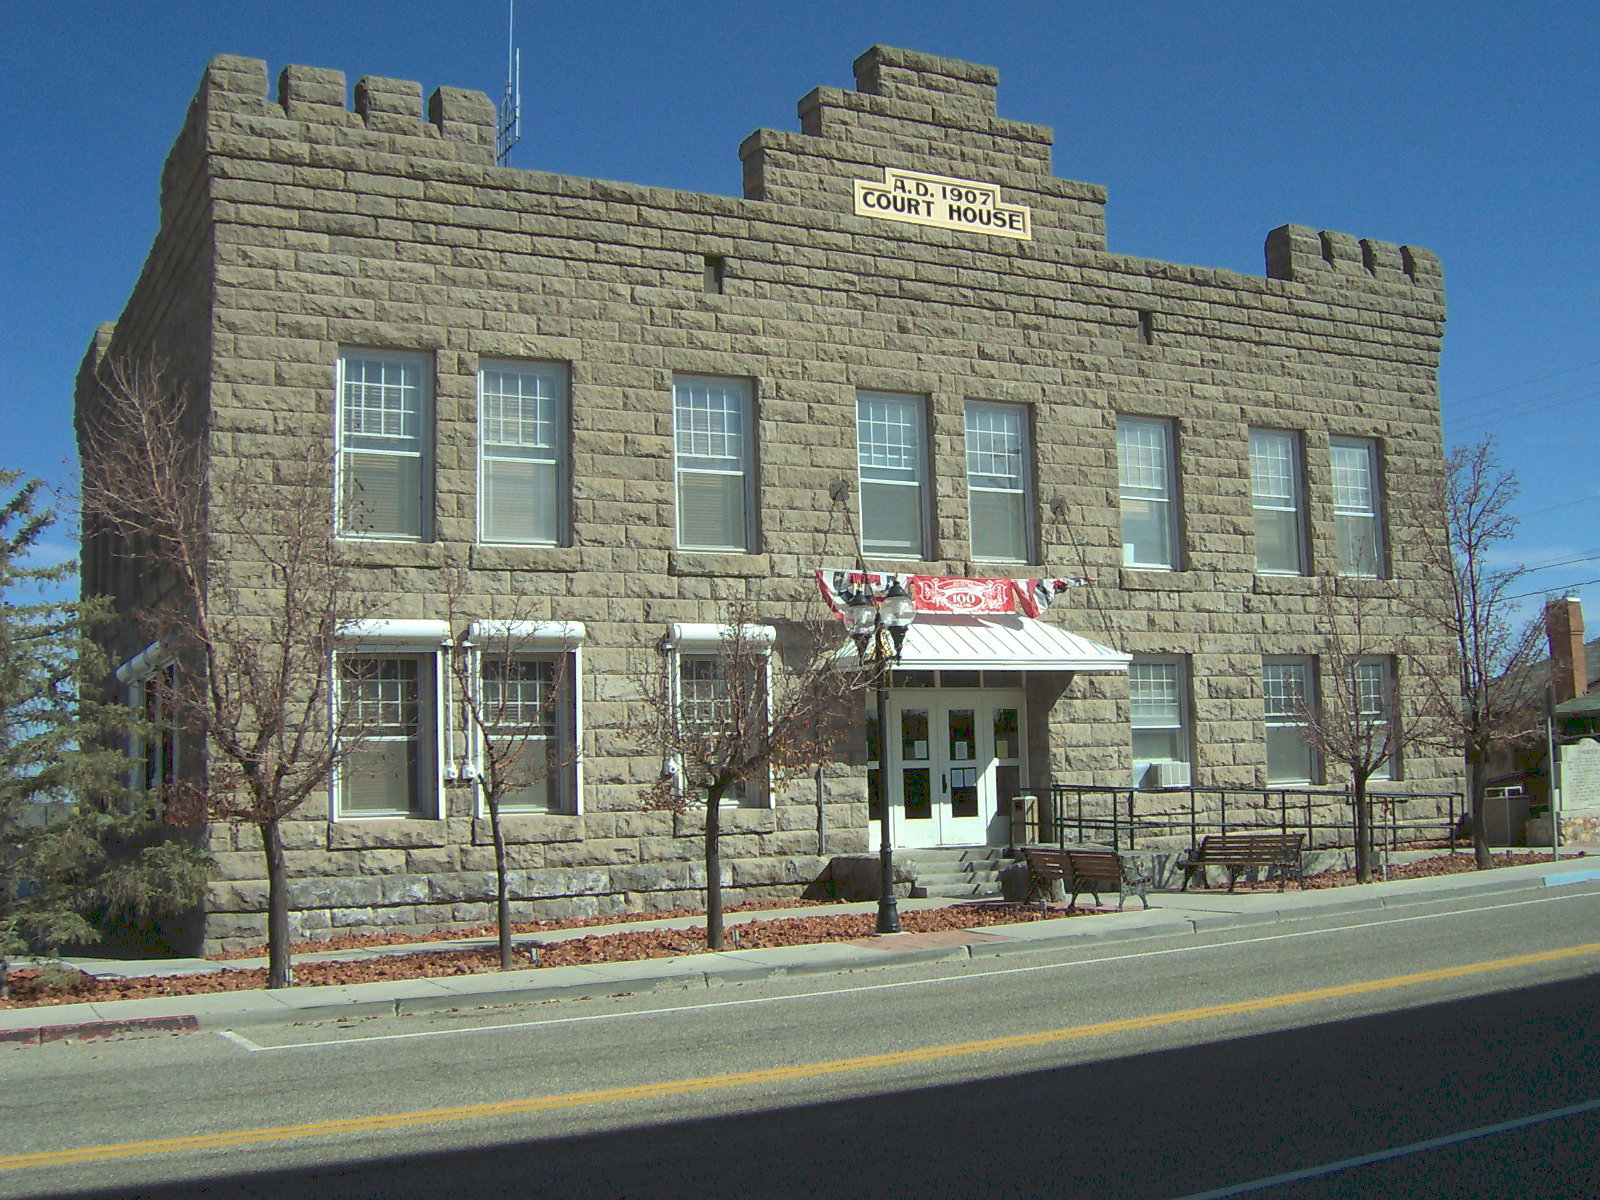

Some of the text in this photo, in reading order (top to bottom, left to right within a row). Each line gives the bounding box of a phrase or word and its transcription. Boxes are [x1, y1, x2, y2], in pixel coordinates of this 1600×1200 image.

[893, 179, 991, 206] A.D. 1907
[862, 191, 1023, 231] COURT HOUSE
[952, 594, 976, 603] 100
